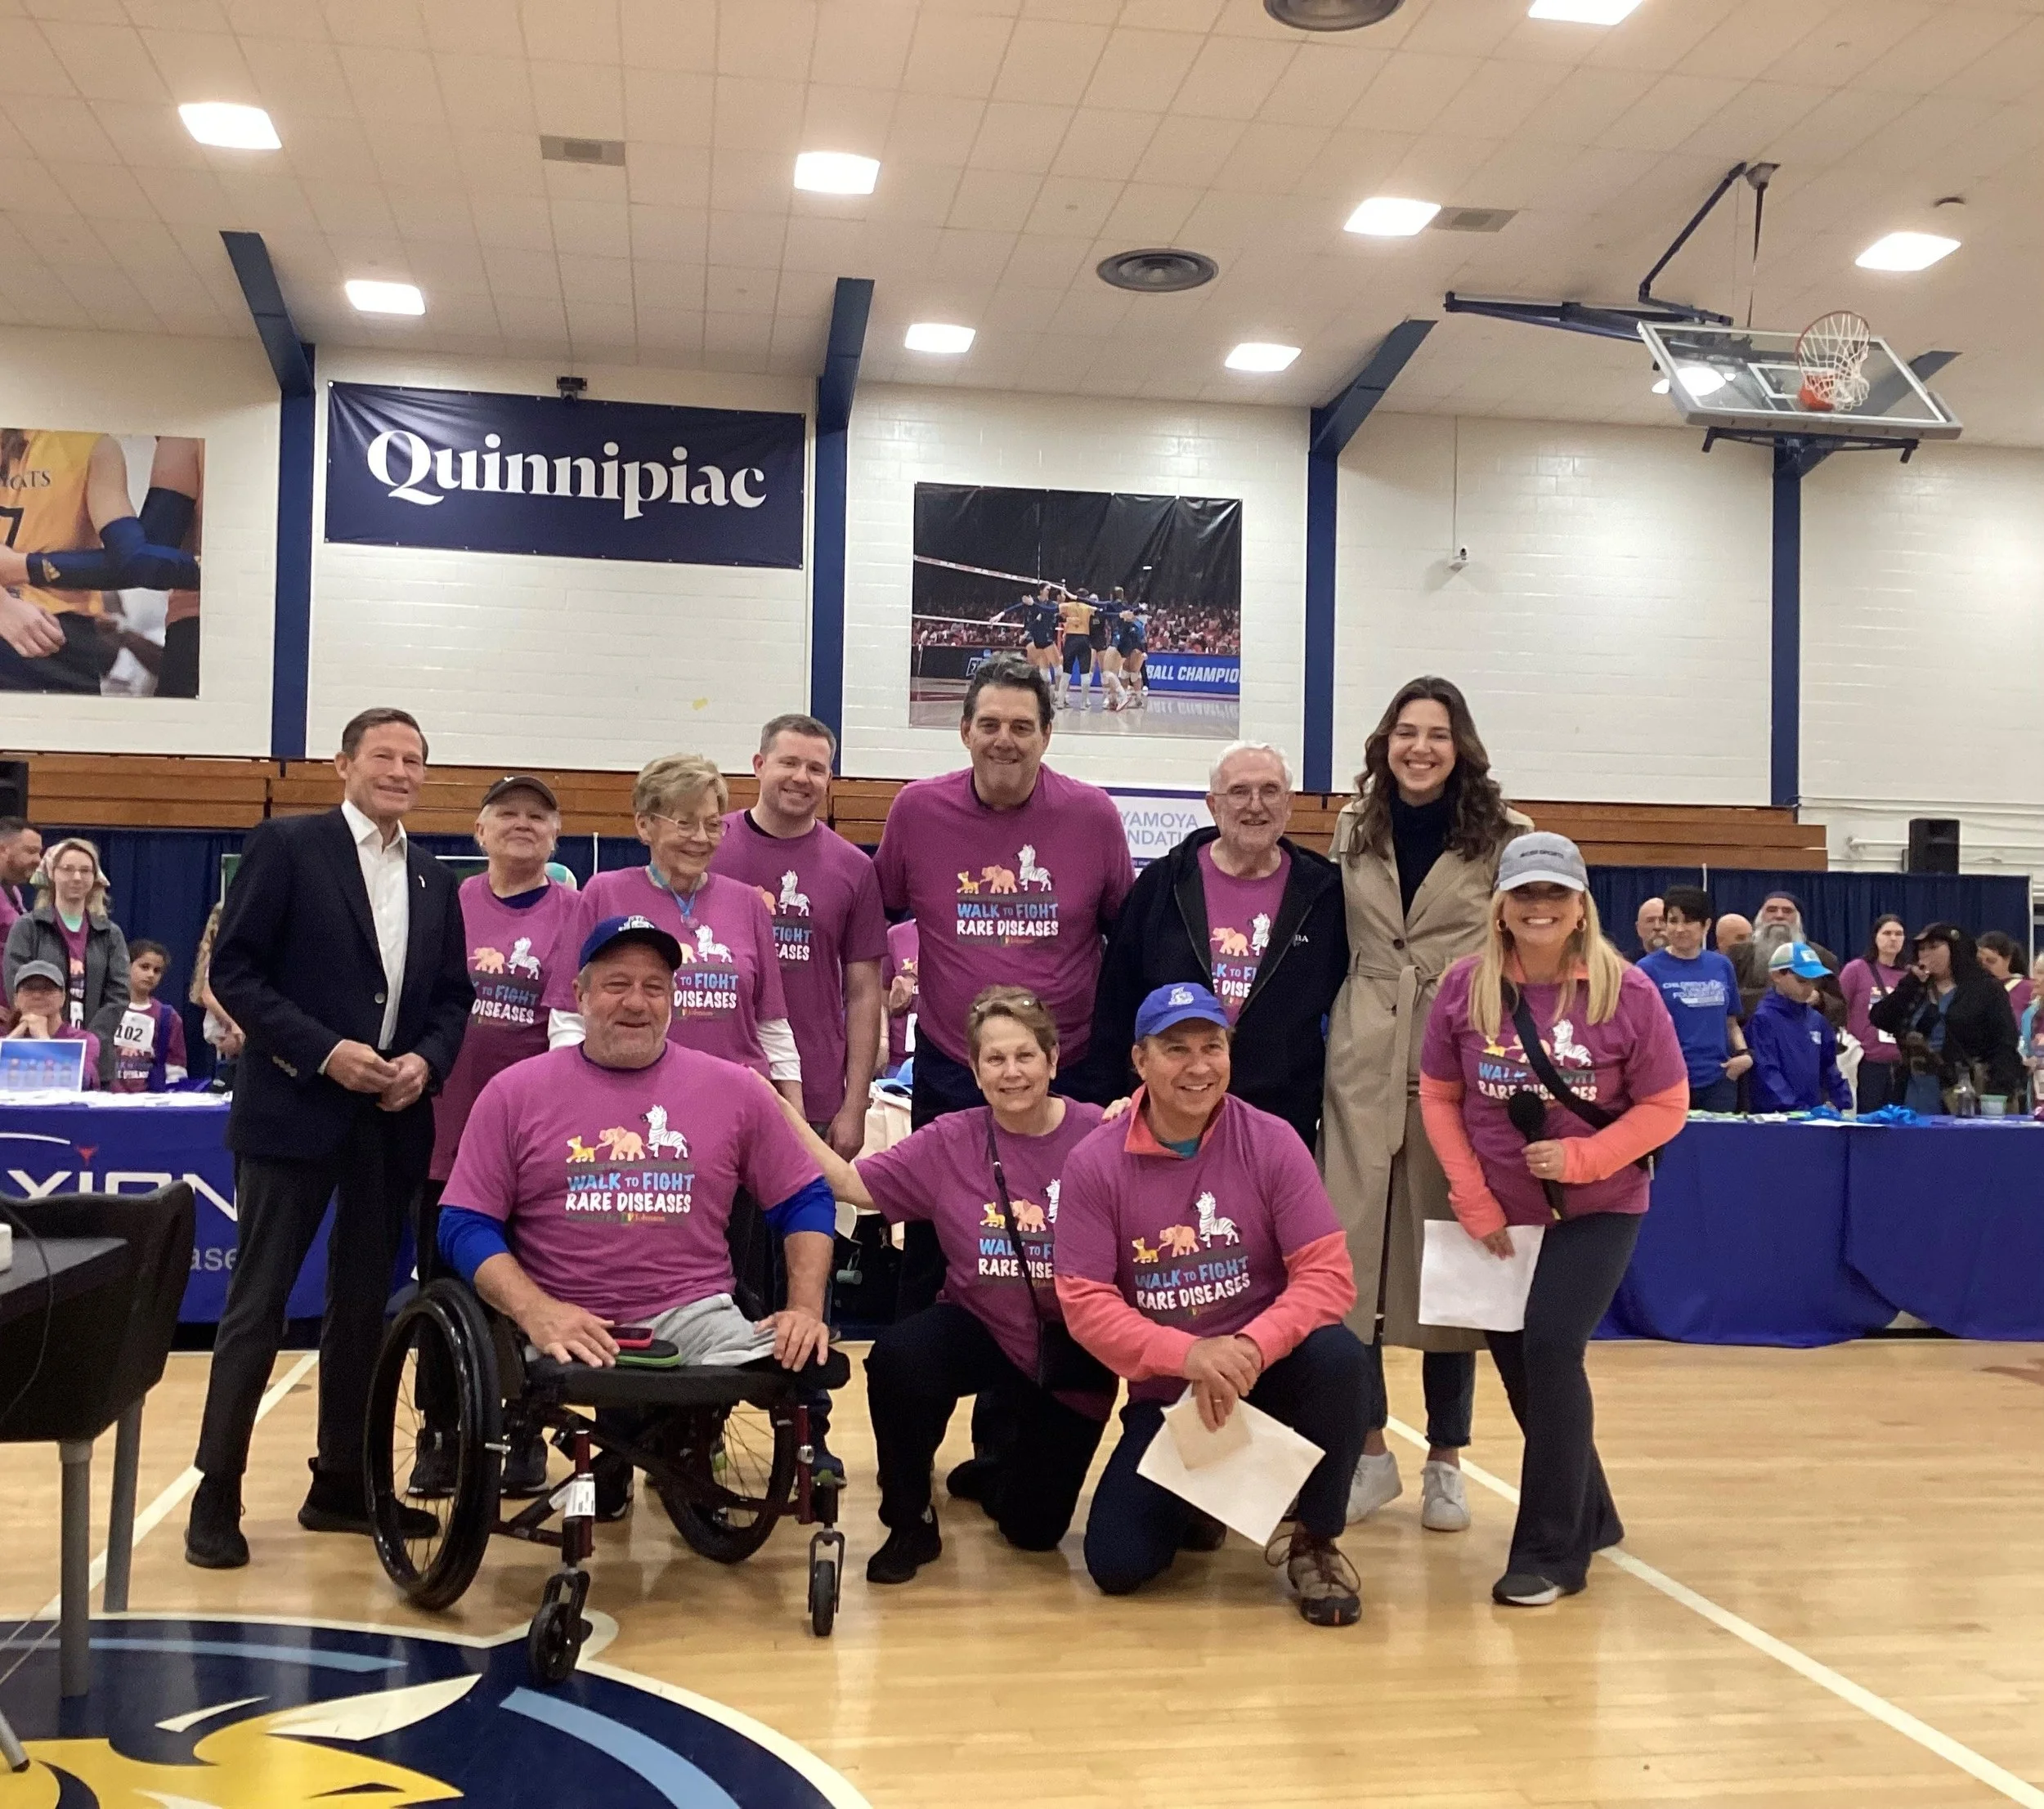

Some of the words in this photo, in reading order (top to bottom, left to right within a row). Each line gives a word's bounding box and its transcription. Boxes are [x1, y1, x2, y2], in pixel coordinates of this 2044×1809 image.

[366, 429, 767, 520] Quinnipiac
[1145, 665, 1174, 681] BALL
[1119, 810, 1199, 829] YAMOYA
[957, 903, 1000, 918] WALK
[1003, 907, 1014, 916] TO
[1015, 903, 1059, 919] FIGHT
[773, 926, 812, 943] FIGHT
[957, 920, 994, 936] RARE
[997, 920, 1059, 937] DISEASES
[774, 943, 810, 961] ASES
[680, 975, 692, 986] TO
[695, 973, 738, 990] FIGHT
[1230, 969, 1241, 977] TO
[482, 986, 493, 996] TO
[495, 984, 540, 1006] FIGHT
[673, 990, 737, 1009] DISEASES
[471, 998, 535, 1024] DISEASES
[115, 1024, 143, 1042] 102
[567, 1172, 621, 1192] WALK
[625, 1176, 639, 1188] TO
[643, 1171, 695, 1192] FIGHT
[565, 1192, 612, 1211] RARE
[616, 1193, 692, 1213] DISEASES
[979, 1238, 1025, 1256] WAL
[1029, 1246, 1041, 1256] TO
[978, 1258, 1019, 1277] RARE
[1135, 1269, 1181, 1289] WALK
[1183, 1272, 1197, 1282] TO
[1199, 1256, 1248, 1283] FIGHT
[1136, 1290, 1177, 1310] RARE
[1179, 1273, 1250, 1307] DISEASES
